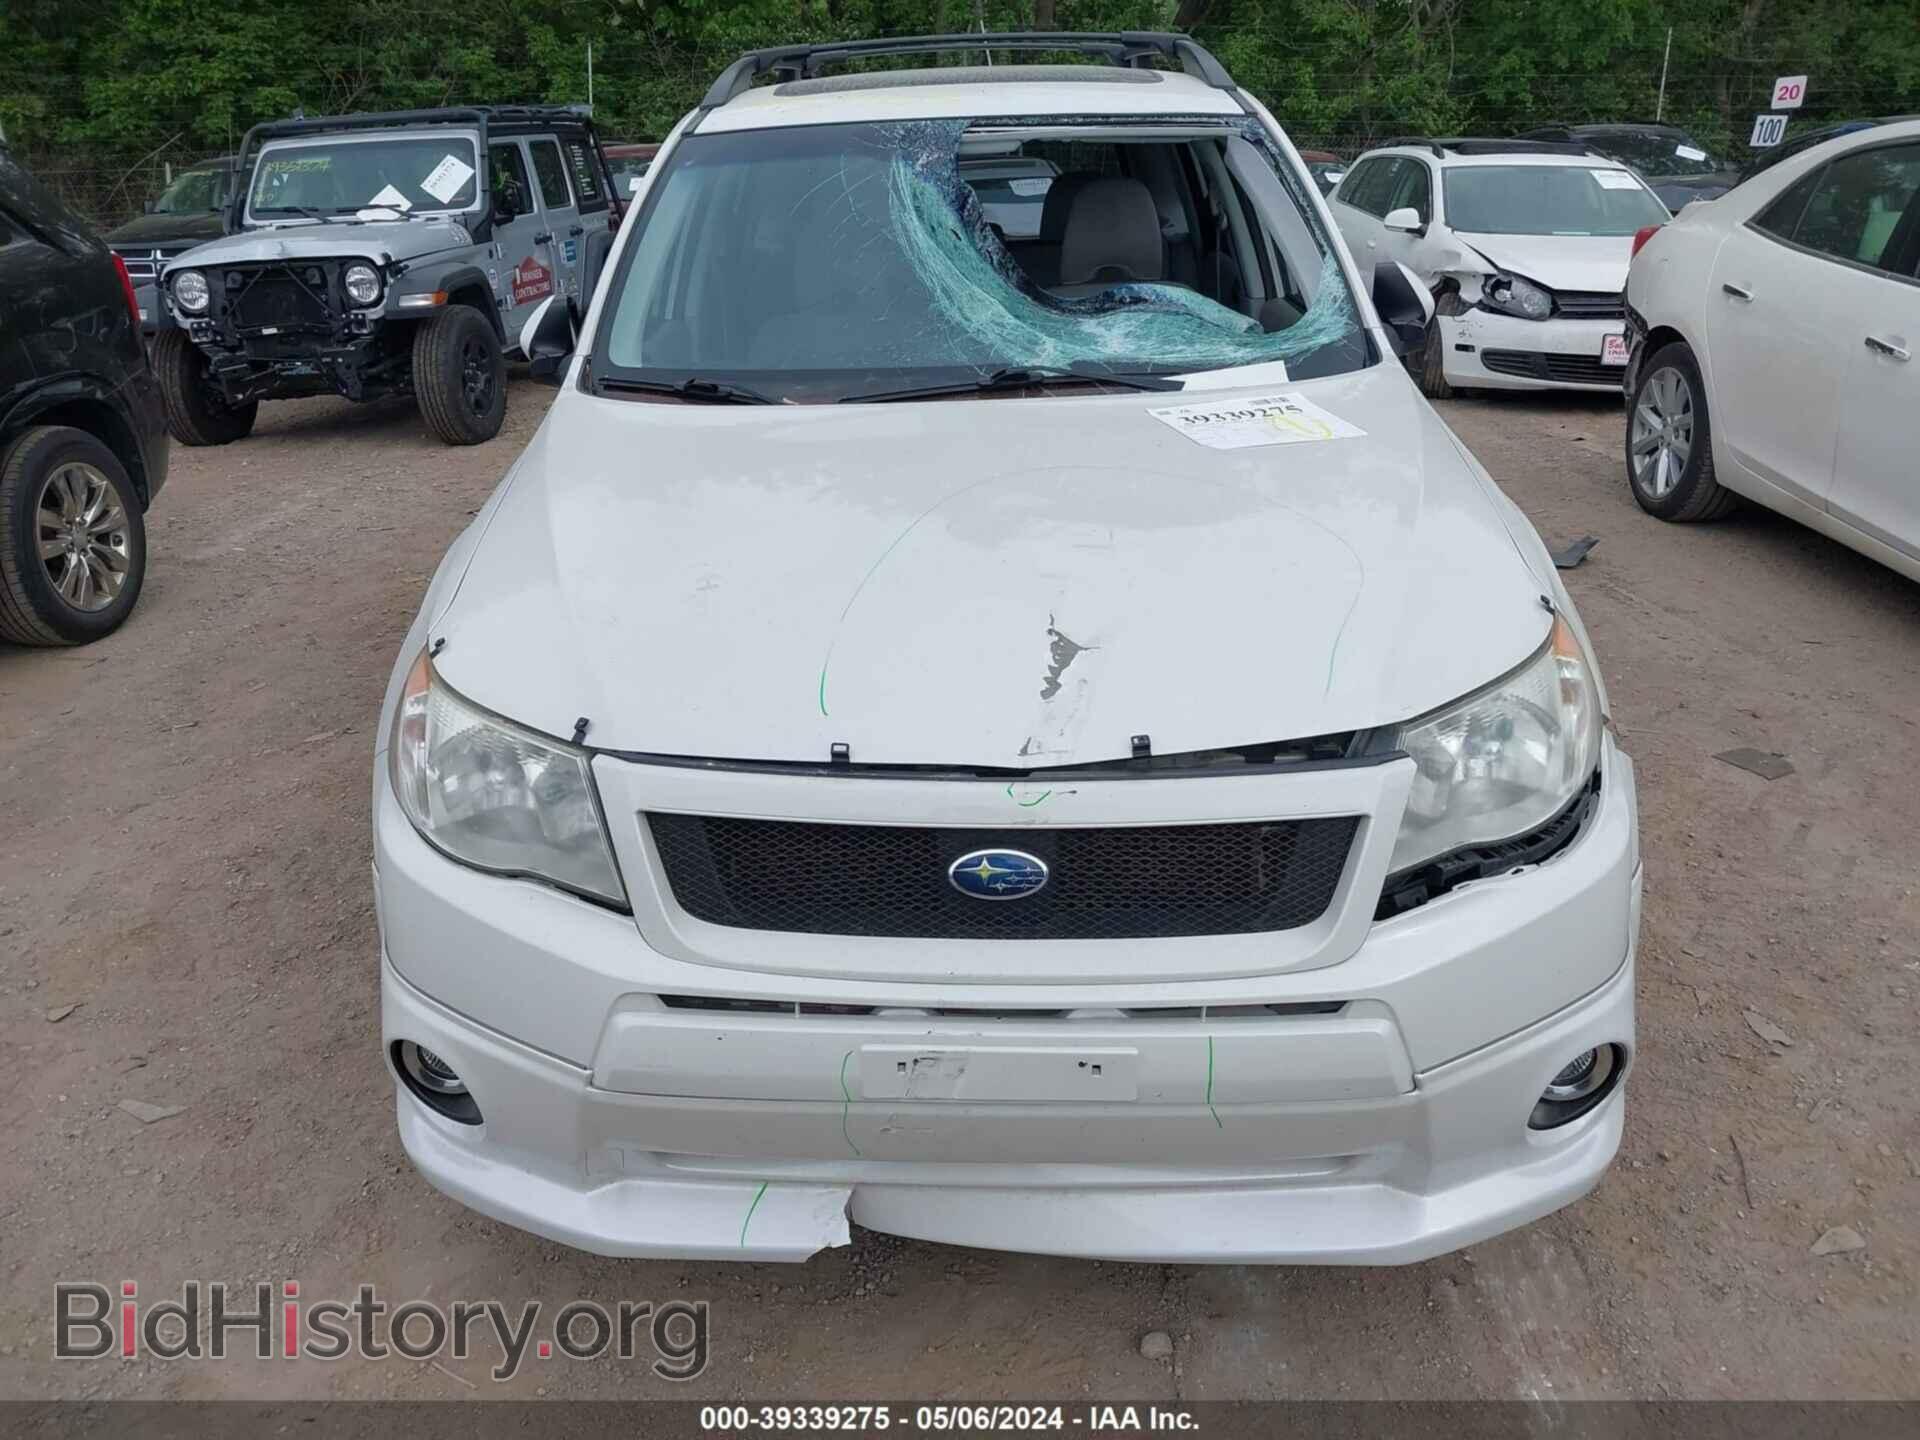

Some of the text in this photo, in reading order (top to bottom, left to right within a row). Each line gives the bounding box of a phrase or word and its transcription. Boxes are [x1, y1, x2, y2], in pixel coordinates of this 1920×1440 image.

[1777, 84, 1800, 101] 20
[1757, 118, 1782, 144] 100
[1178, 404, 1303, 425] 39339275
